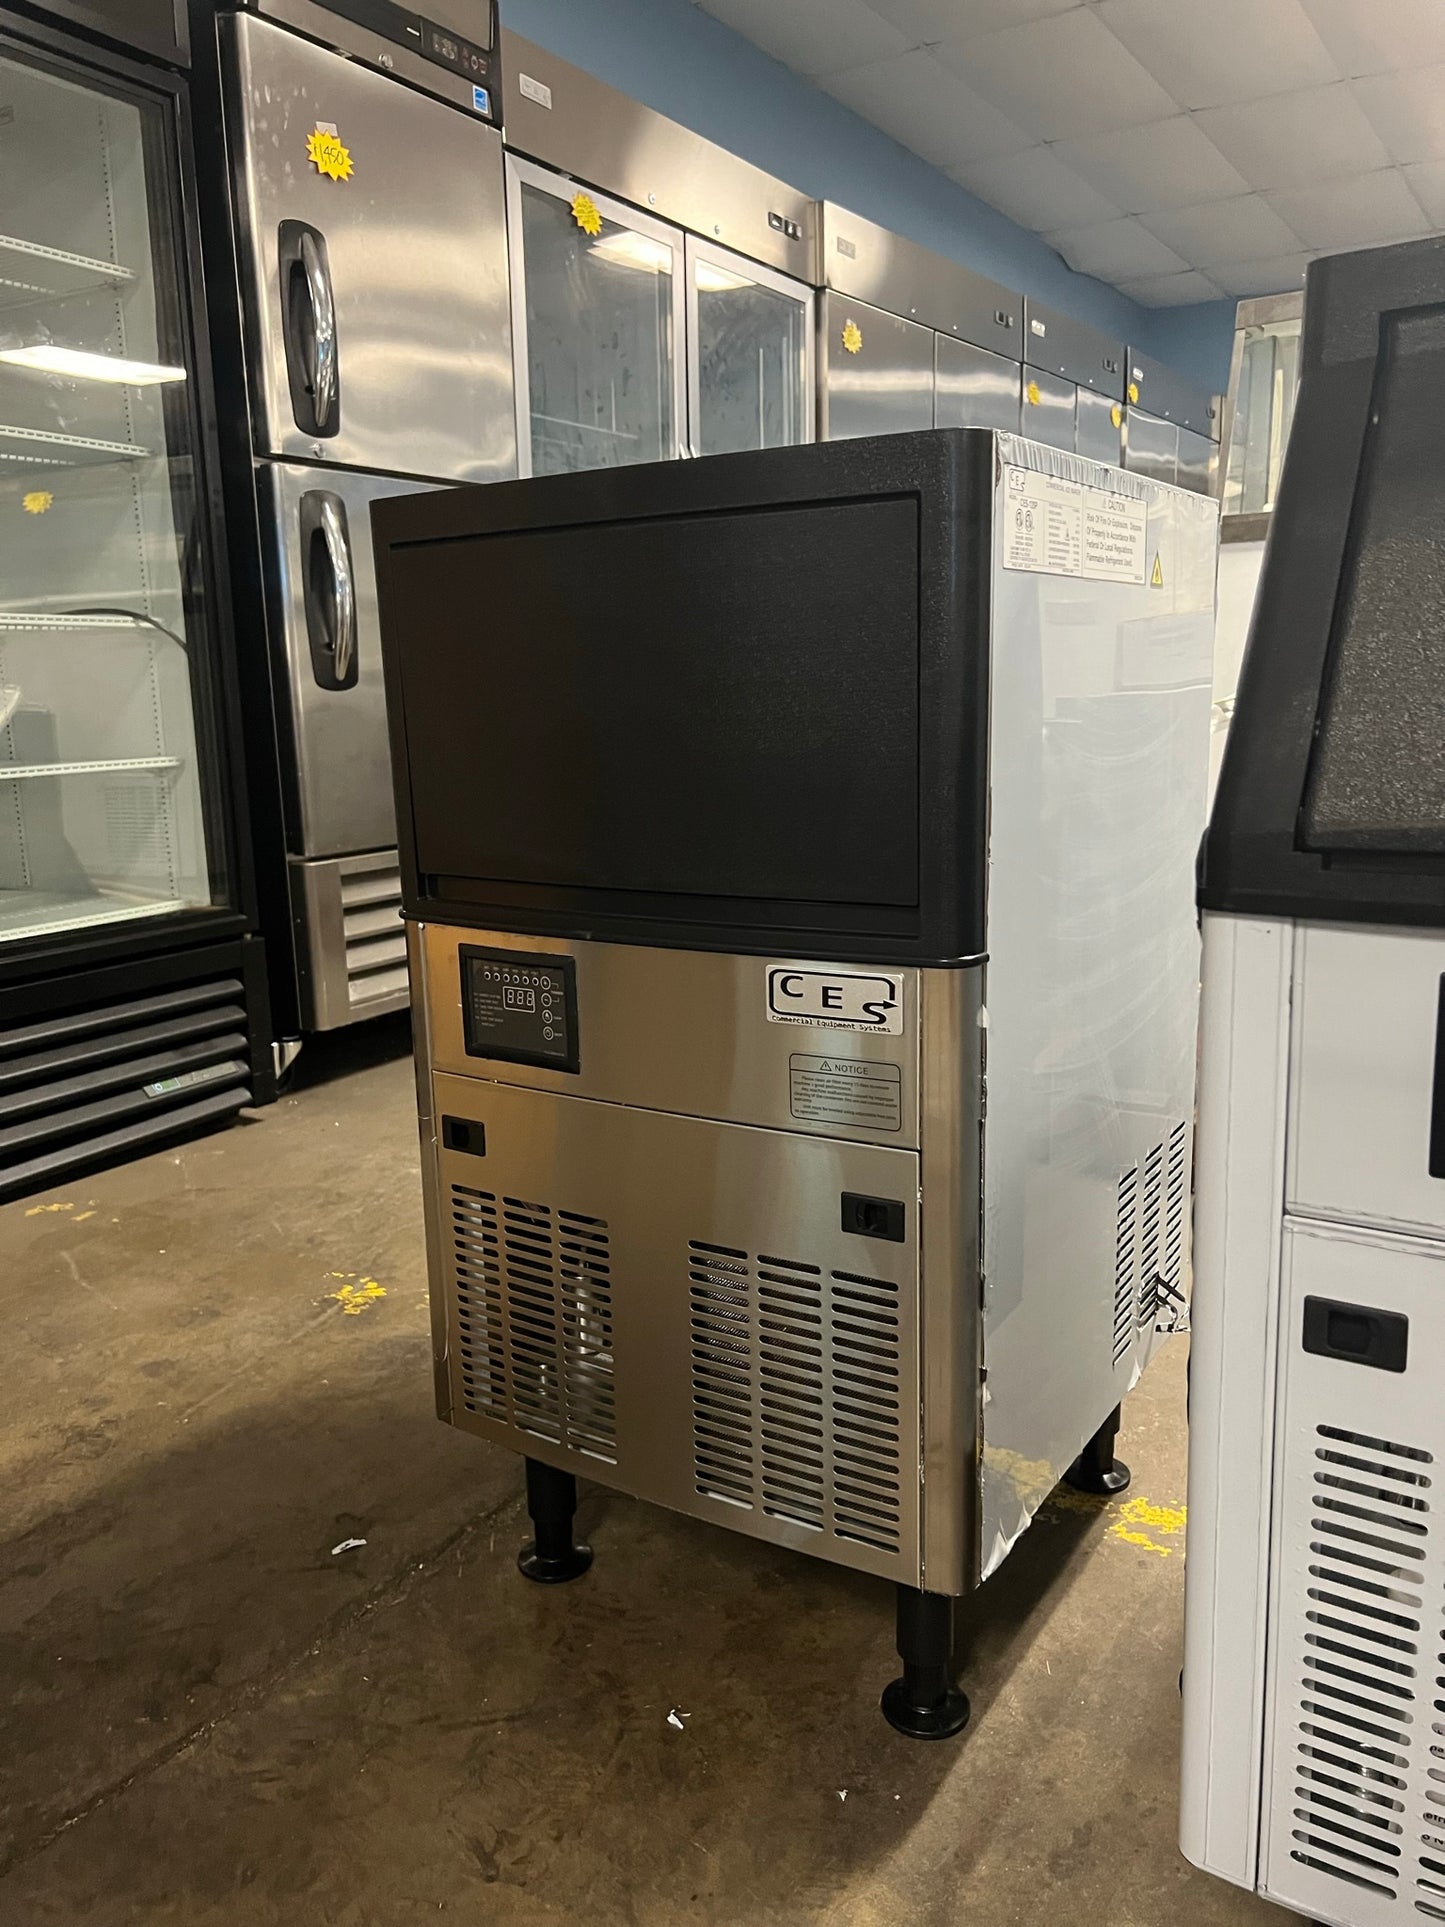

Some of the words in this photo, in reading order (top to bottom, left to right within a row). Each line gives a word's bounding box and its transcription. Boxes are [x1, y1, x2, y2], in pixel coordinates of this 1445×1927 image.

[1010, 470, 1025, 491] CES
[1108, 499, 1126, 513] CAUTION
[780, 975, 893, 1025] CES
[772, 1015, 813, 1026] Commercial
[817, 1019, 856, 1030] Equipment
[859, 1024, 892, 1033] Systems
[835, 1064, 869, 1075] NOTICE
